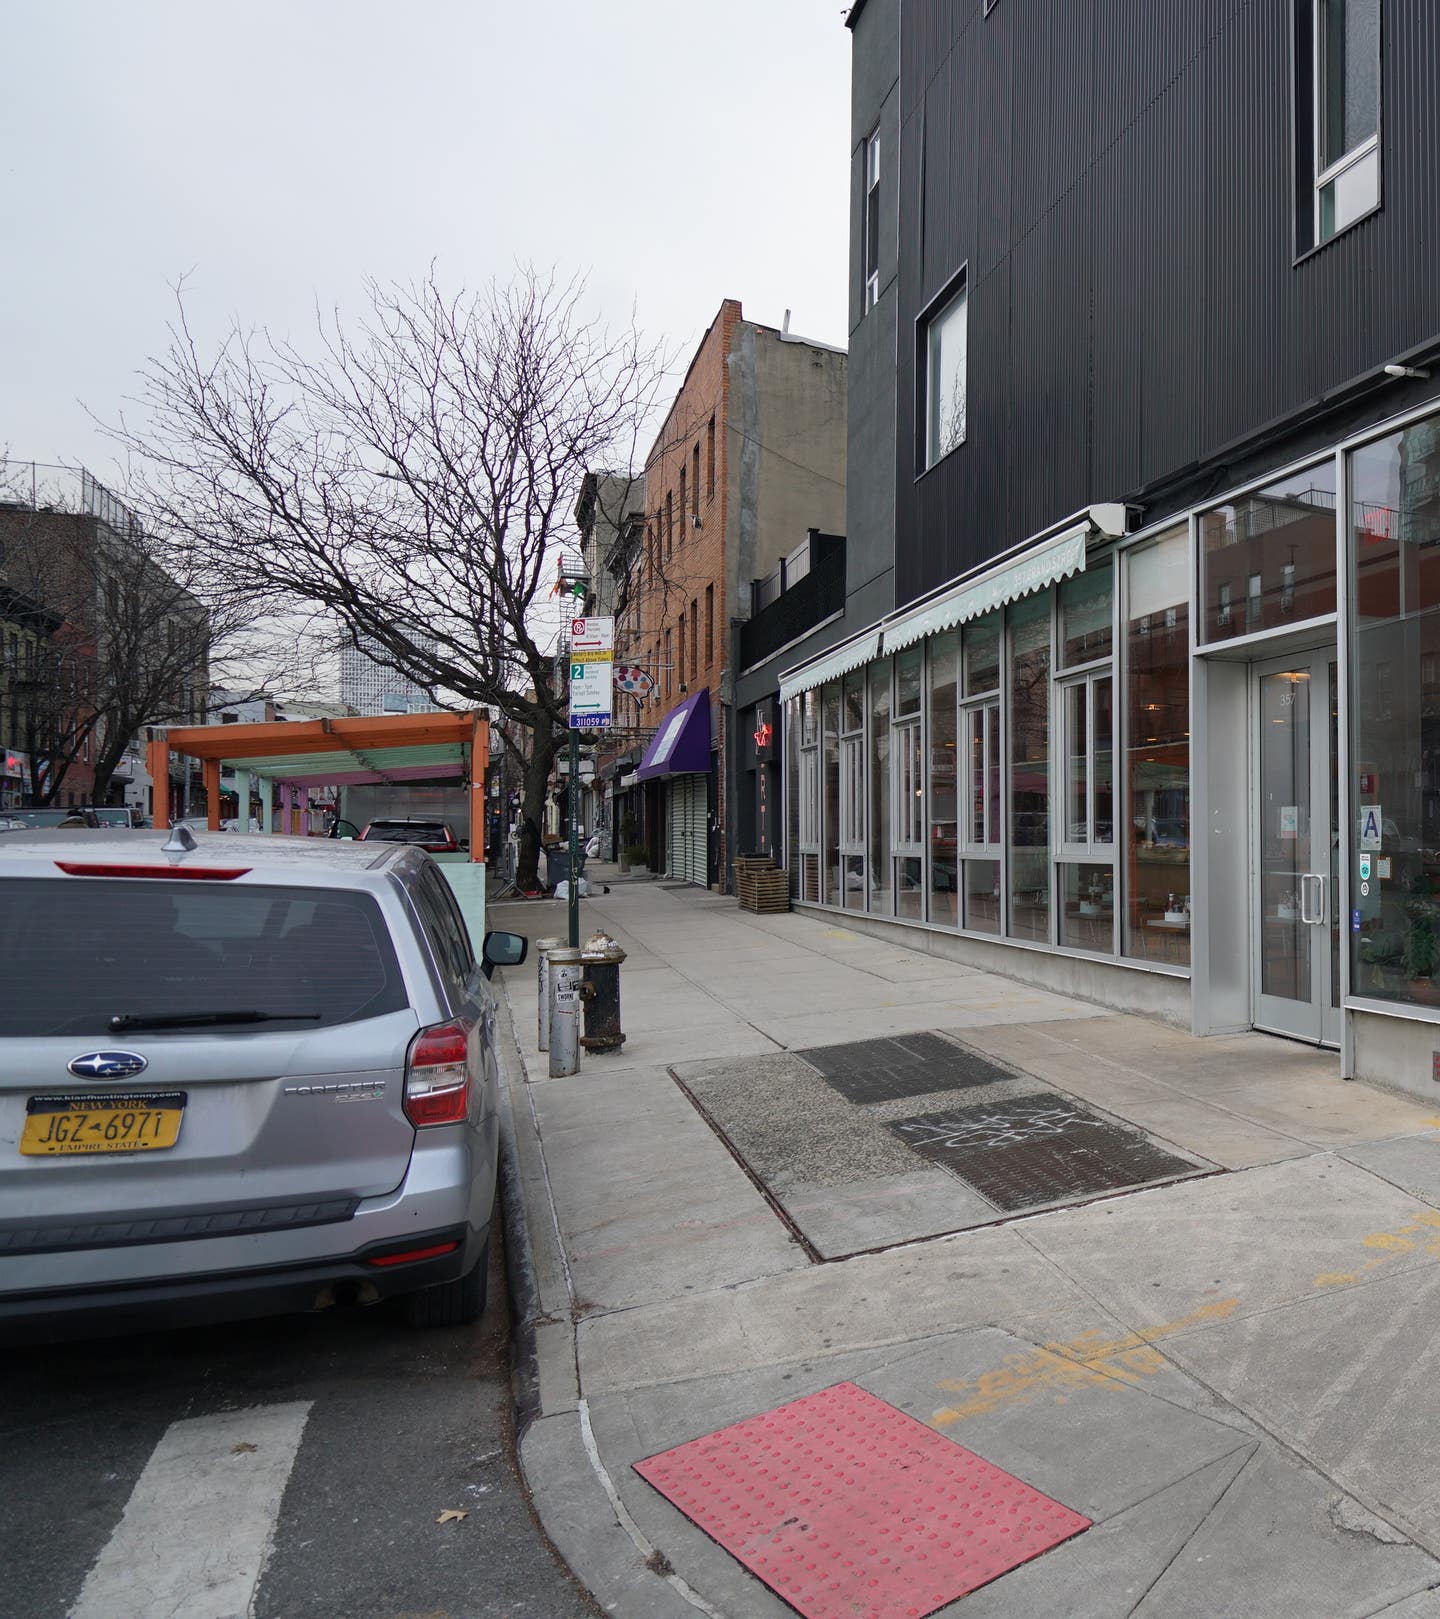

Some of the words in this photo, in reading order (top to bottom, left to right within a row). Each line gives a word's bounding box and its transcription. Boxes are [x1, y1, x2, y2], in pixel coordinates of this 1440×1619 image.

[574, 666, 581, 678] 2
[576, 718, 600, 727] 311059
[1364, 811, 1378, 837] A
[285, 1081, 385, 1096] FORESTER
[69, 1100, 105, 1111] NEW
[109, 1100, 147, 1110] YORK
[59, 1143, 101, 1151] EMPIRE
